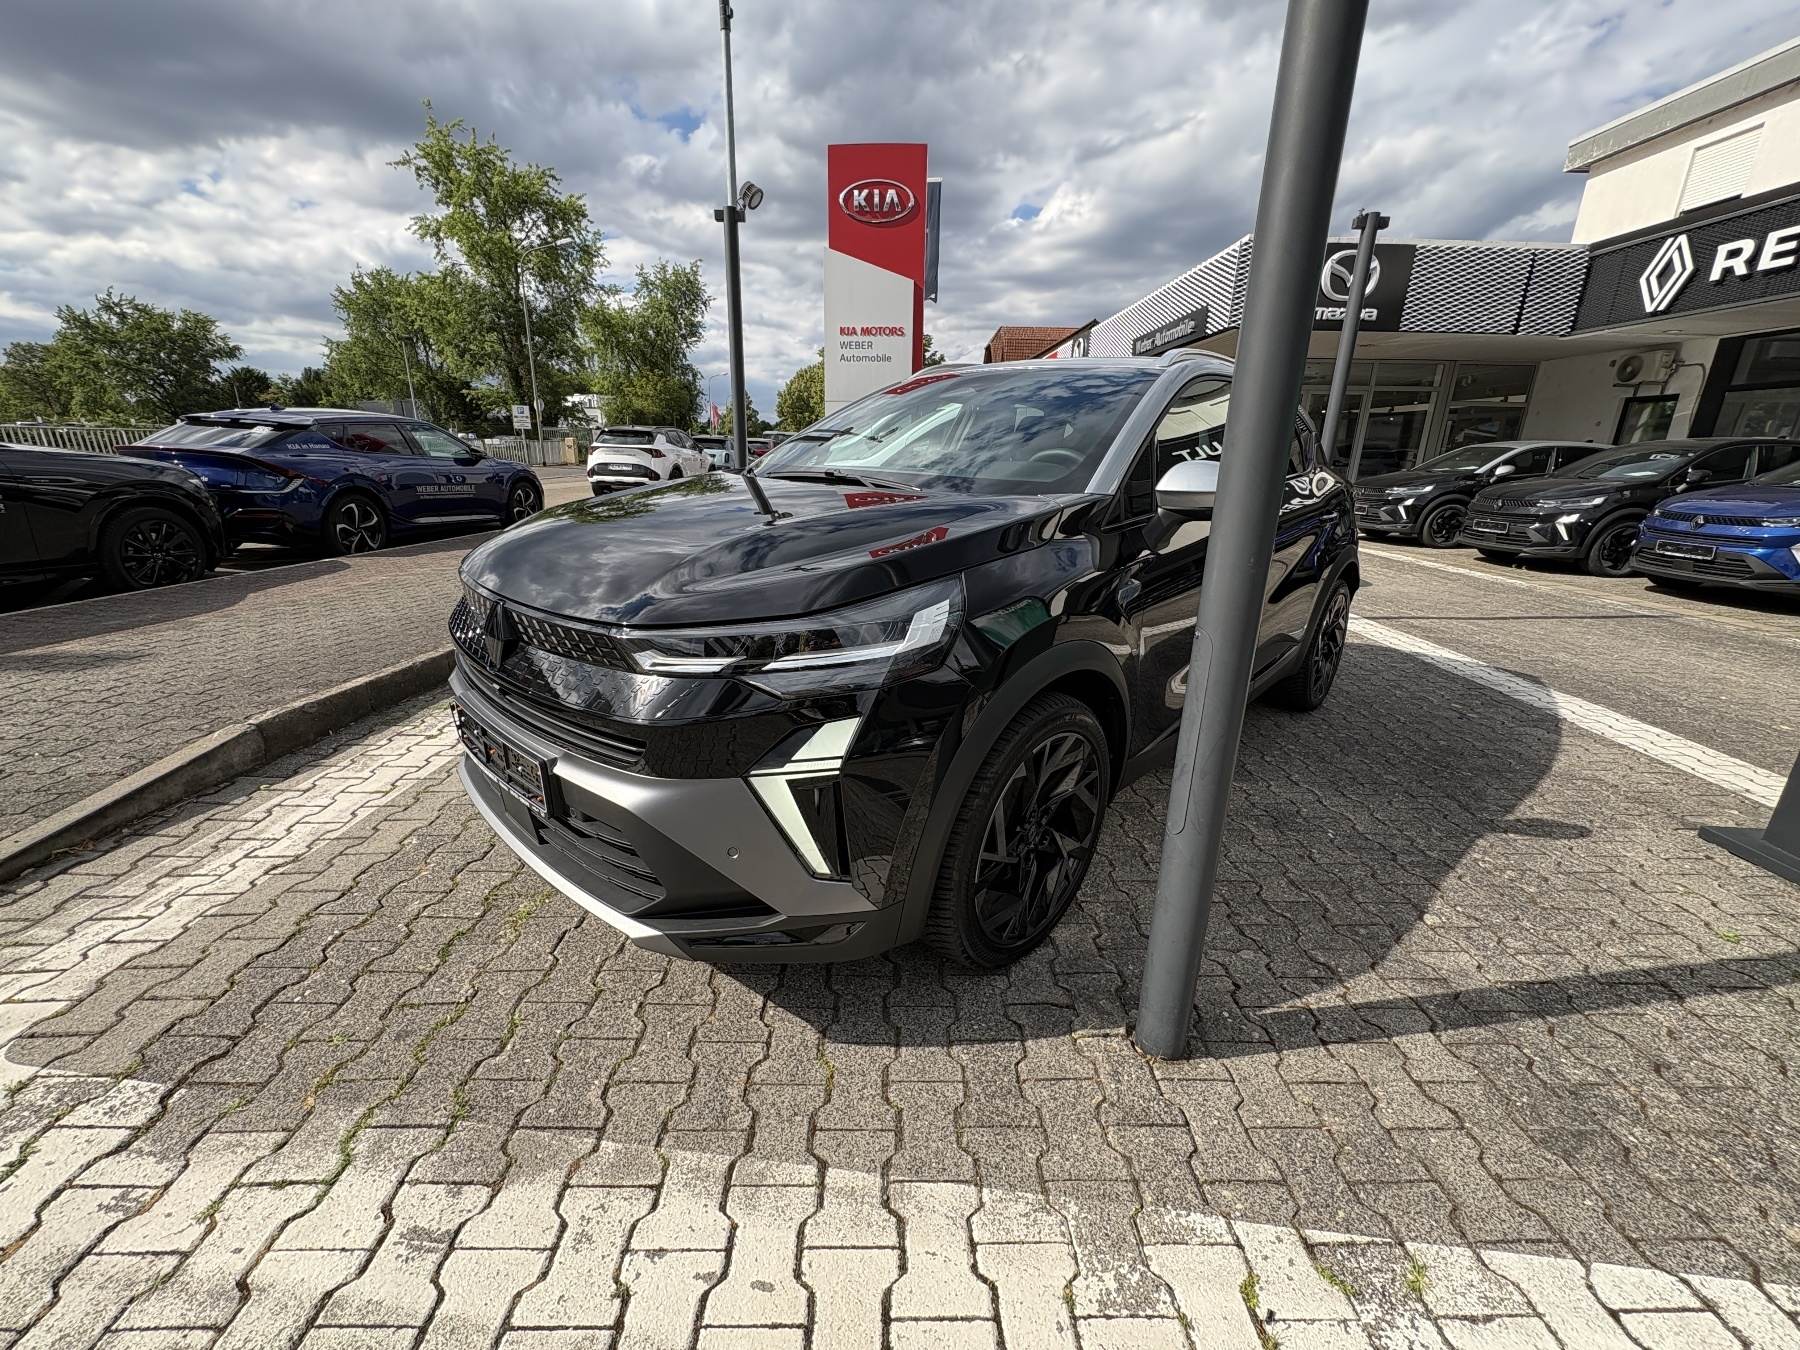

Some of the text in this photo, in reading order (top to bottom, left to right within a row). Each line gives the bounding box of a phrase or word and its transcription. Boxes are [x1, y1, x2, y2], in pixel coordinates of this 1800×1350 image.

[852, 188, 902, 212] KIA
[1709, 225, 1800, 282] RE
[839, 326, 905, 337] KIA MOTORS
[840, 341, 873, 350] WEBER
[840, 353, 892, 363] Automobile
[416, 484, 476, 493] WEBER AUTOMOBILE
